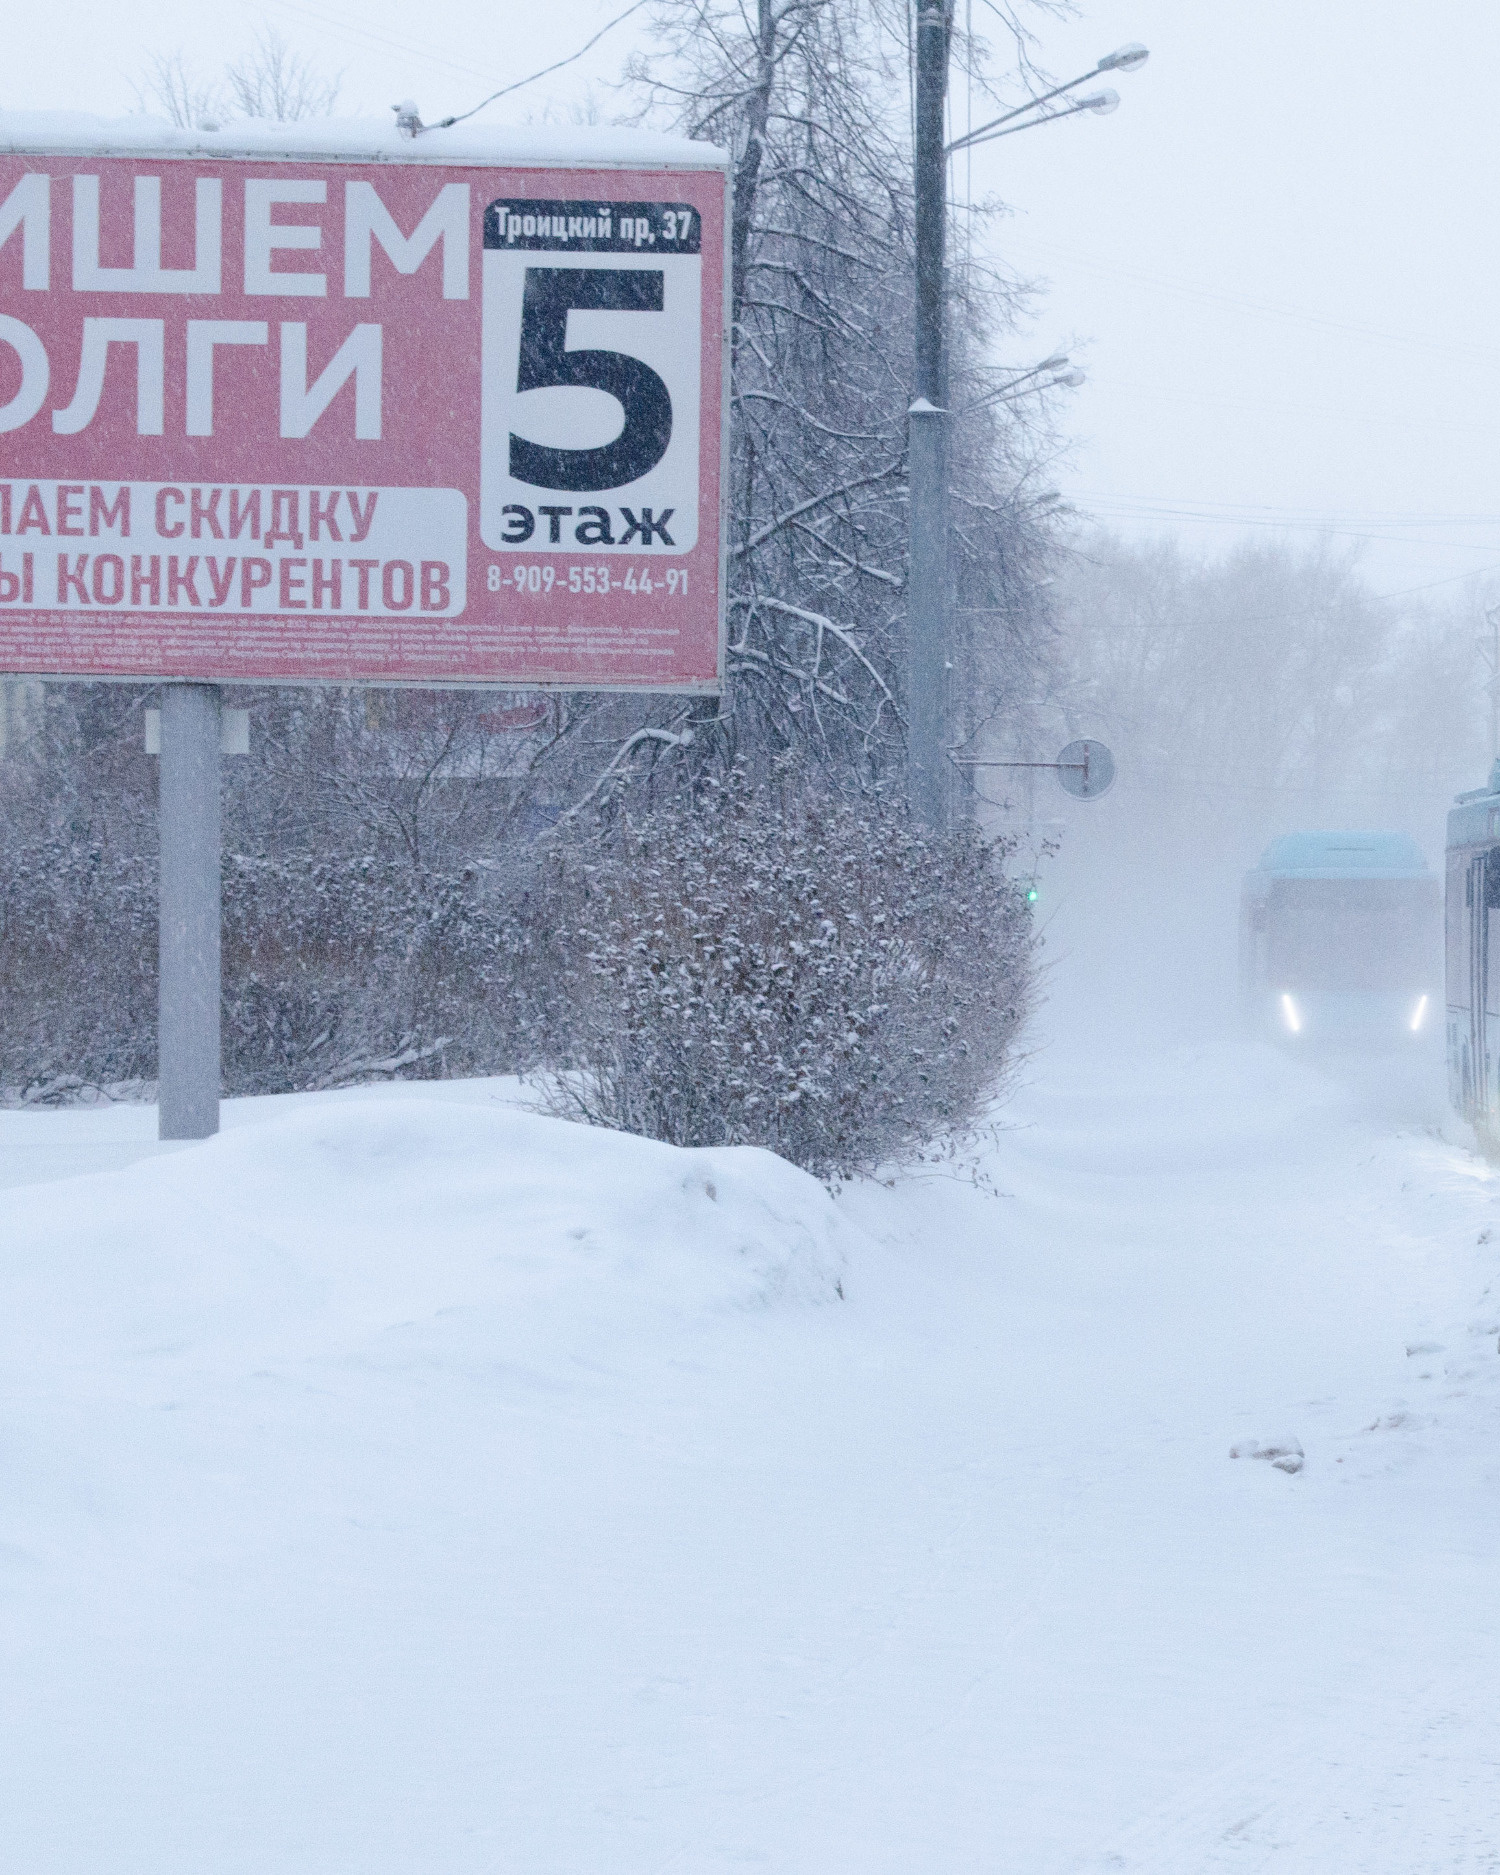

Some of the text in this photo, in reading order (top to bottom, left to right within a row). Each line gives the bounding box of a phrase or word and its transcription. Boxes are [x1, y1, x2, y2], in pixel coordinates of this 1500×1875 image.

[495, 206, 612, 243] Троицкий
[662, 210, 693, 240] 37
[509, 266, 674, 493] 5
[155, 486, 379, 550] СКИДКУ
[500, 502, 677, 547] этаж
[57, 552, 451, 612] КОНКУРЕНТОВ
[487, 566, 690, 597] 8-909-553-44-91
